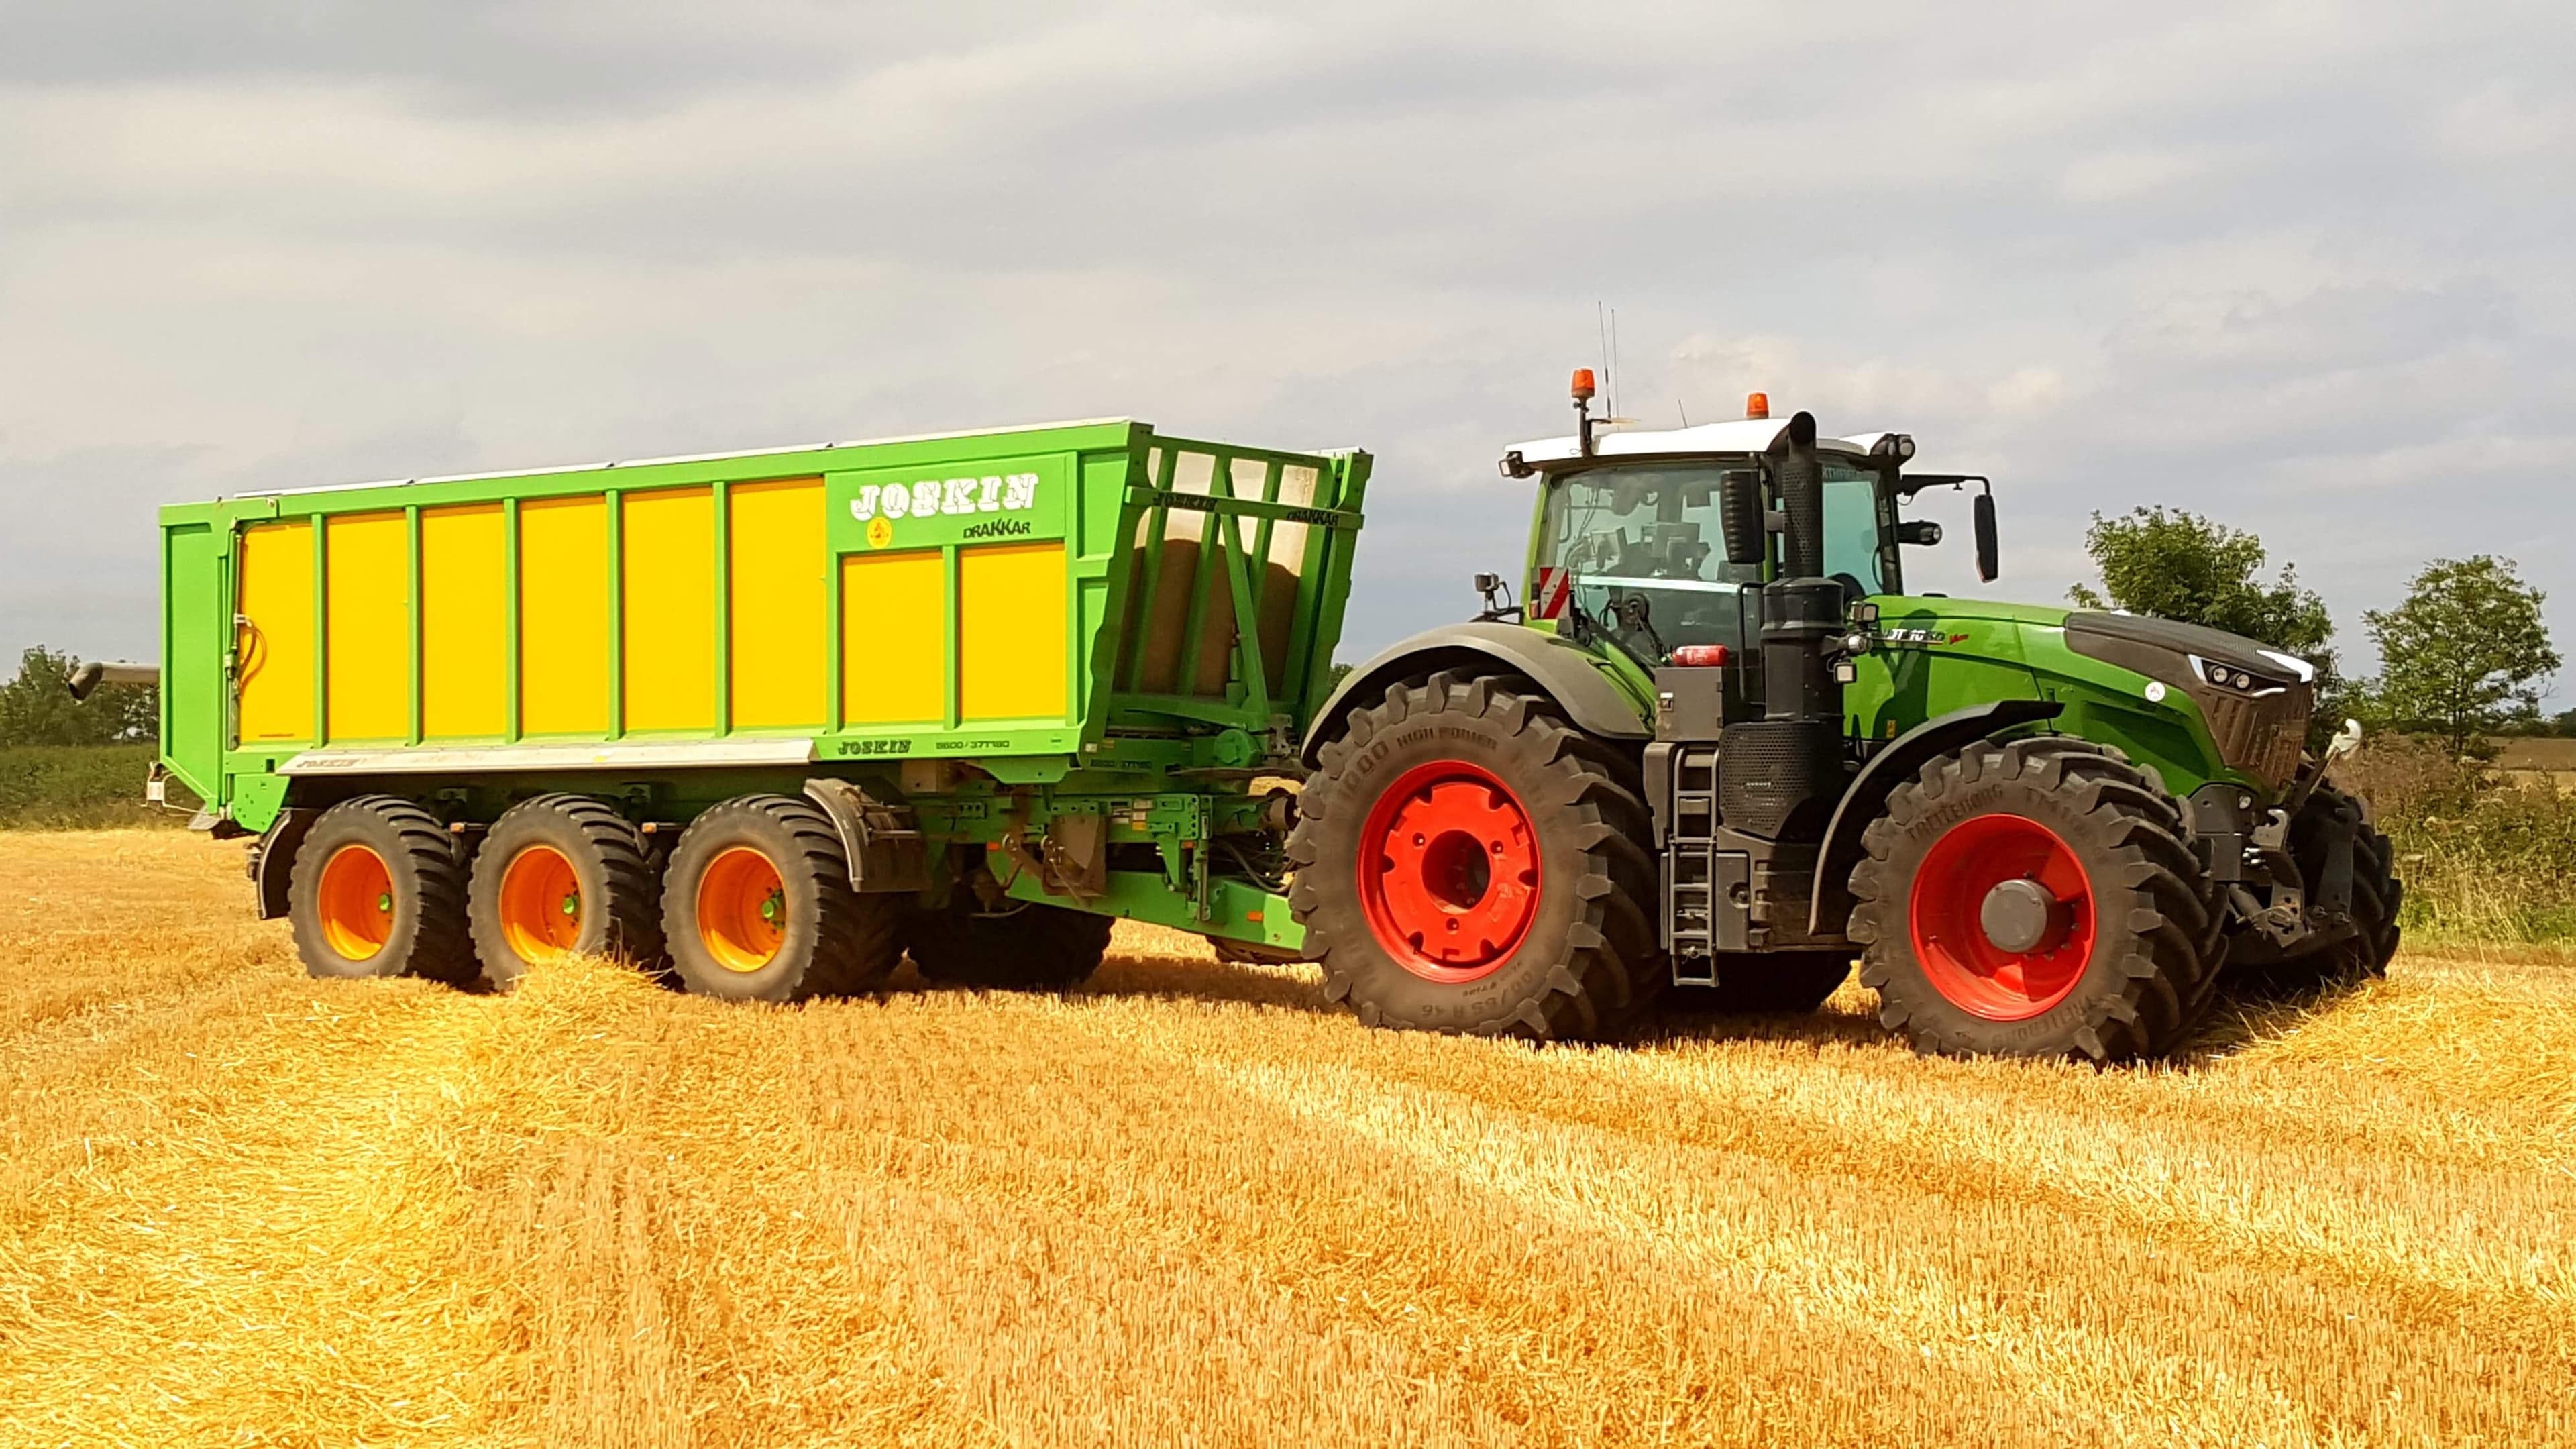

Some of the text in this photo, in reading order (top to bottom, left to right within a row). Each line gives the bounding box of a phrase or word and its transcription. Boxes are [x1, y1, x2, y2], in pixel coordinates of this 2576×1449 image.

[850, 473, 1039, 521] JOSKIN
[963, 519, 1031, 539] DRAKKAR
[838, 739, 912, 755] JOSKIN
